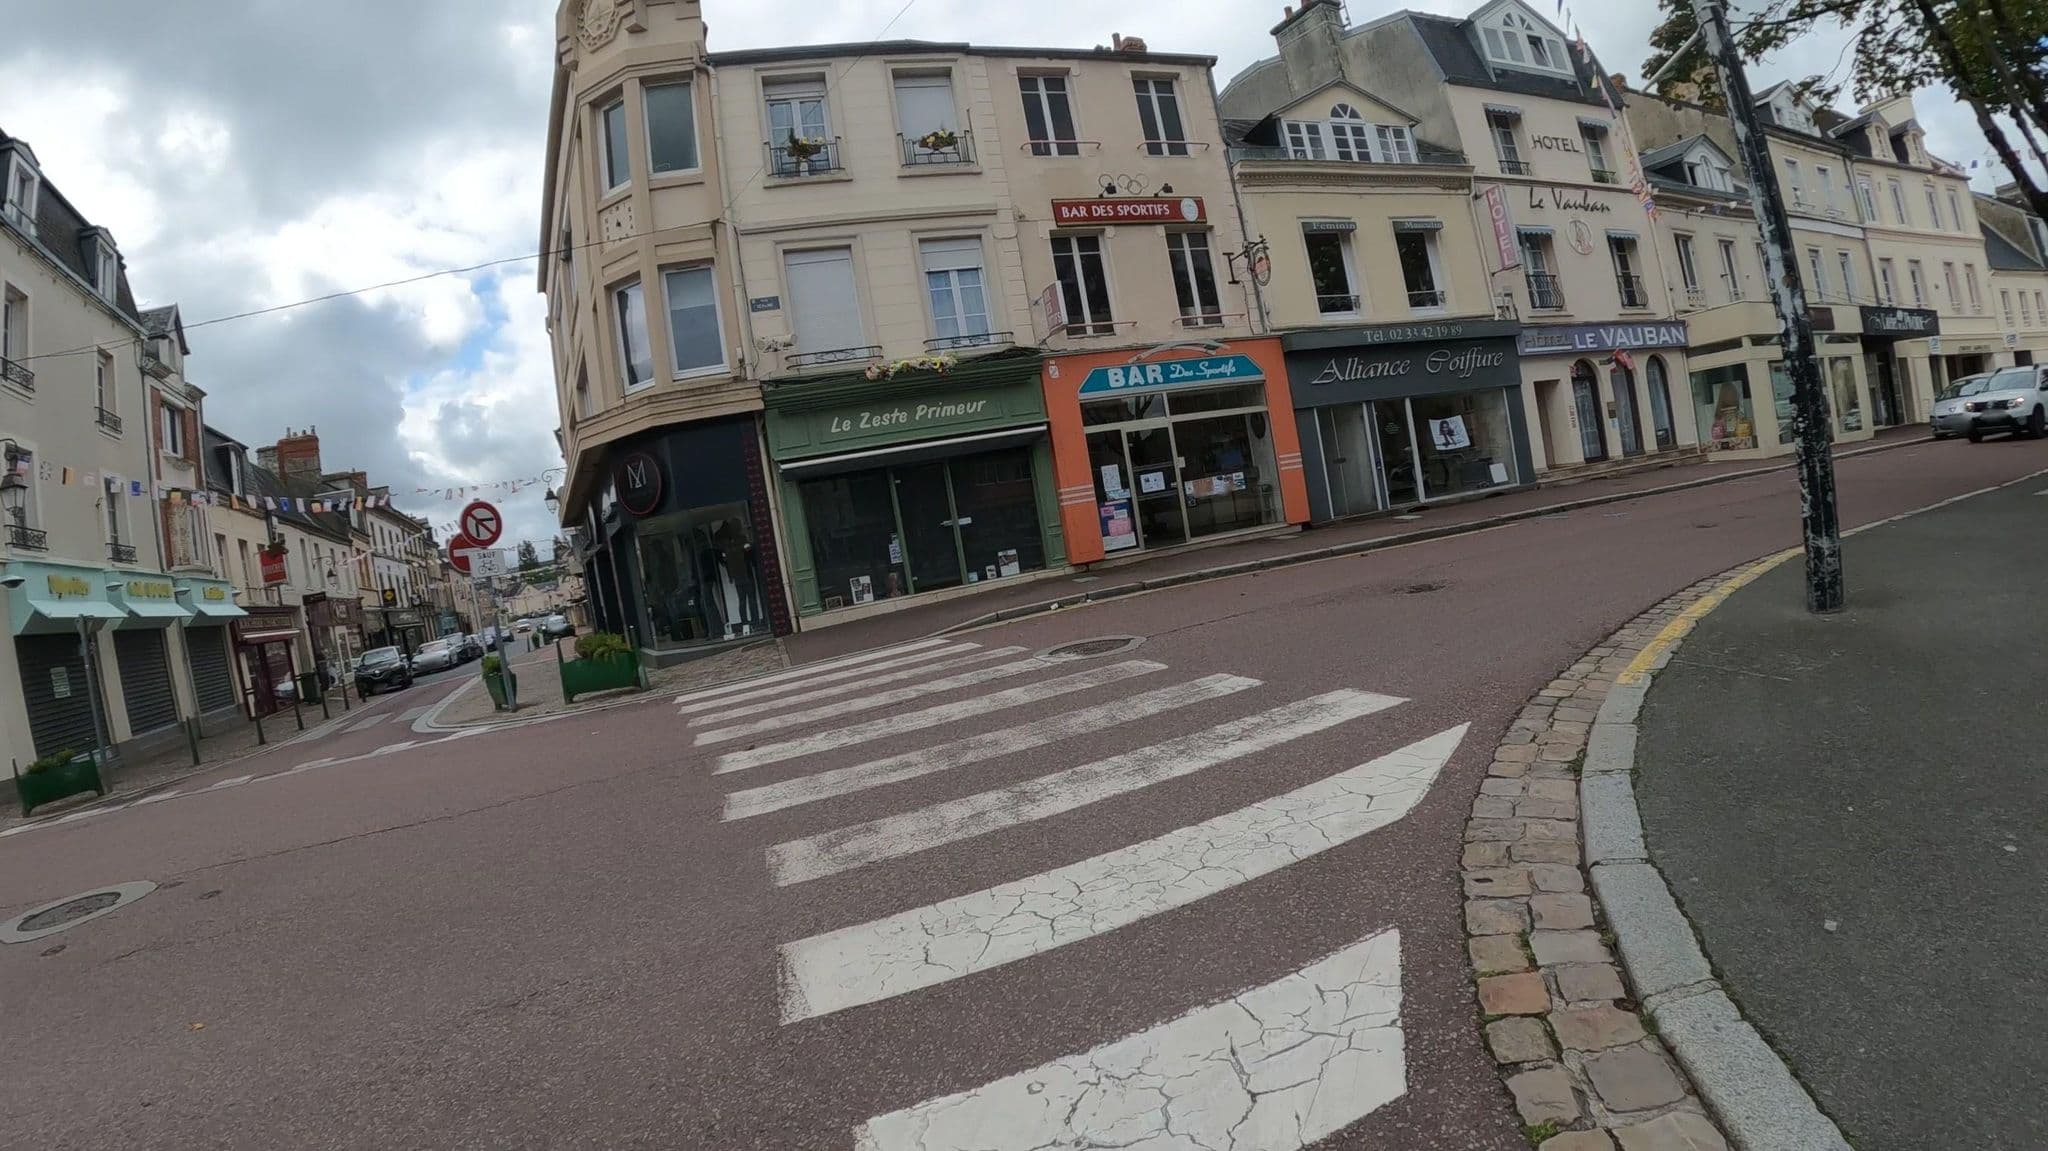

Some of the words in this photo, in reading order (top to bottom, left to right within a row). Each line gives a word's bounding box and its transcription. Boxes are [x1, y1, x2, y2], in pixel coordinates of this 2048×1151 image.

[1531, 134, 1580, 153] HOTEL
[1062, 205, 1088, 218] BAR
[1092, 204, 1114, 217] DES
[1117, 203, 1170, 216] SPORTIFS
[1529, 187, 1544, 210] Le
[1551, 188, 1611, 213] Vauban
[1487, 187, 1516, 266] HOTEL
[1389, 328, 1403, 340] 02
[1406, 327, 1419, 339] 33
[1421, 326, 1434, 338] 42
[1436, 325, 1448, 337] 19
[1574, 332, 1598, 349] LE
[1599, 326, 1686, 348] VAUBAN
[1107, 365, 1164, 388] BAR
[1169, 363, 1194, 379] Des
[1195, 360, 1236, 378] Sportifs
[1311, 356, 1410, 385] Alliance
[1425, 346, 1504, 379] Coiffure
[831, 416, 851, 433] Le
[859, 407, 908, 430] Zeste
[915, 399, 987, 421] Primeur
[477, 551, 496, 559] SAUF
